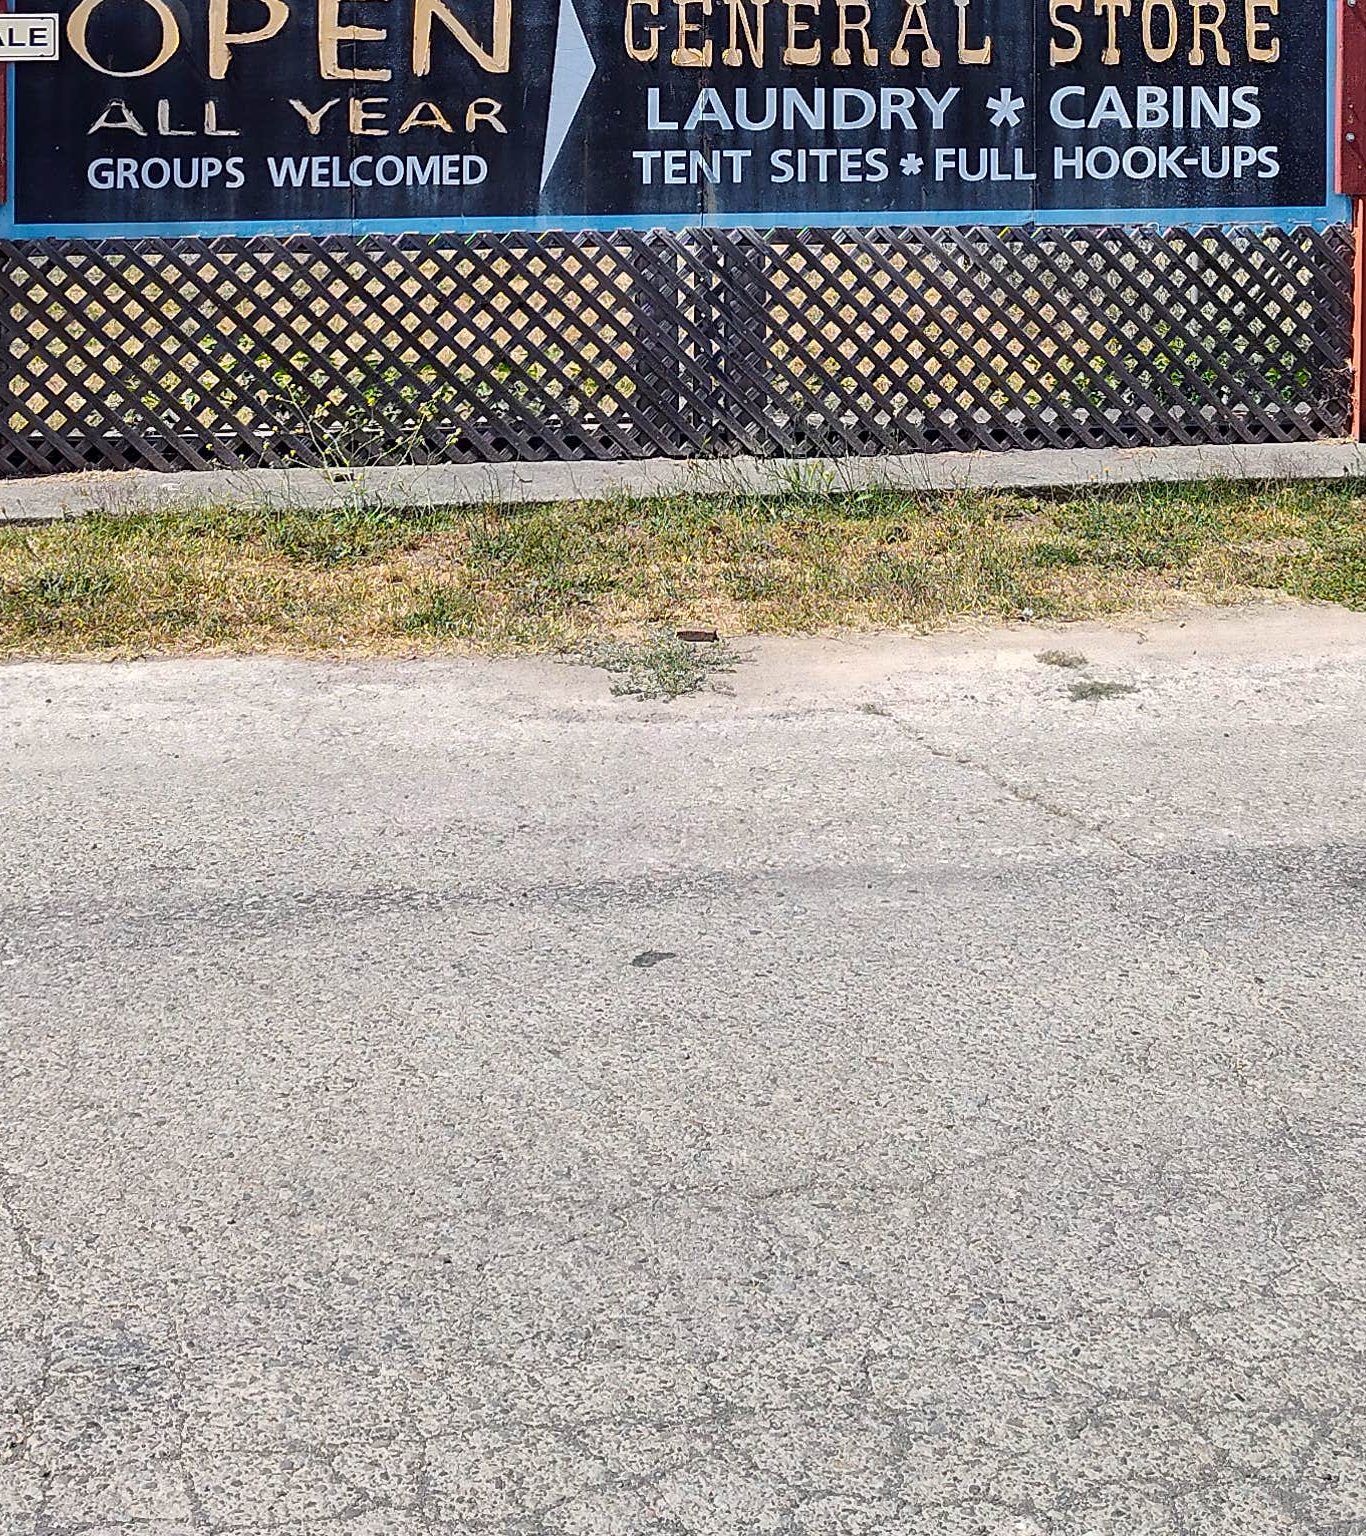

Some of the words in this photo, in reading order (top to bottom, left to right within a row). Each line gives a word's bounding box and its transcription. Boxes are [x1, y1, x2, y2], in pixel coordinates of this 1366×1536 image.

[86, 98, 241, 137] ALL
[288, 97, 508, 137] YEAR
[646, 86, 962, 132] LAUNDRY
[1049, 85, 1263, 131] CABINS
[87, 156, 246, 190] GROUPS
[267, 154, 489, 189] WELCOMED
[632, 149, 753, 186] TENT
[769, 147, 890, 184] SITES
[935, 146, 1037, 183] FULL
[1053, 144, 1281, 182] HOOK-UPS
